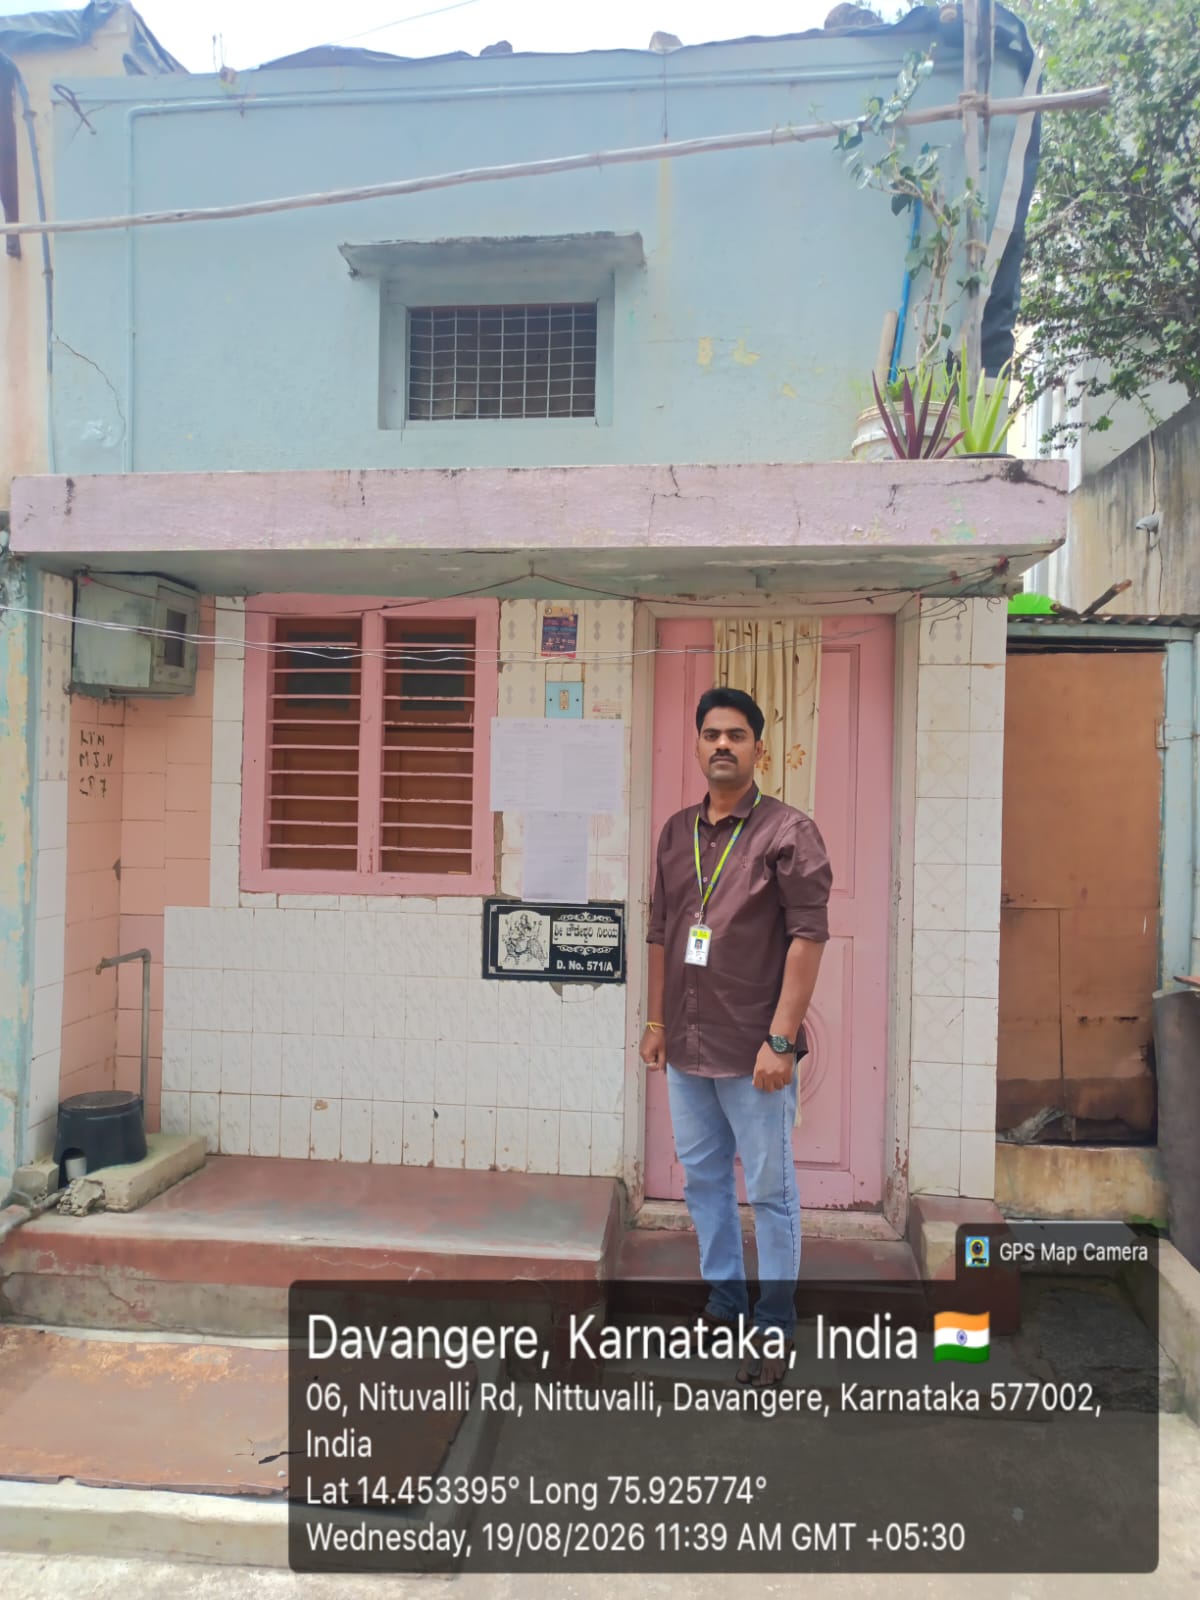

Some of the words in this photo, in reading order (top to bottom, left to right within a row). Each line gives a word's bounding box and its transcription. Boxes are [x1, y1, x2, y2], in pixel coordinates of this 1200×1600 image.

[554, 923, 563, 941] ಶ್ರೀ
[597, 926, 618, 940] ನಿಲಯ
[556, 960, 566, 970] D.
[568, 960, 585, 971] No.
[586, 961, 613, 972] 571/A
